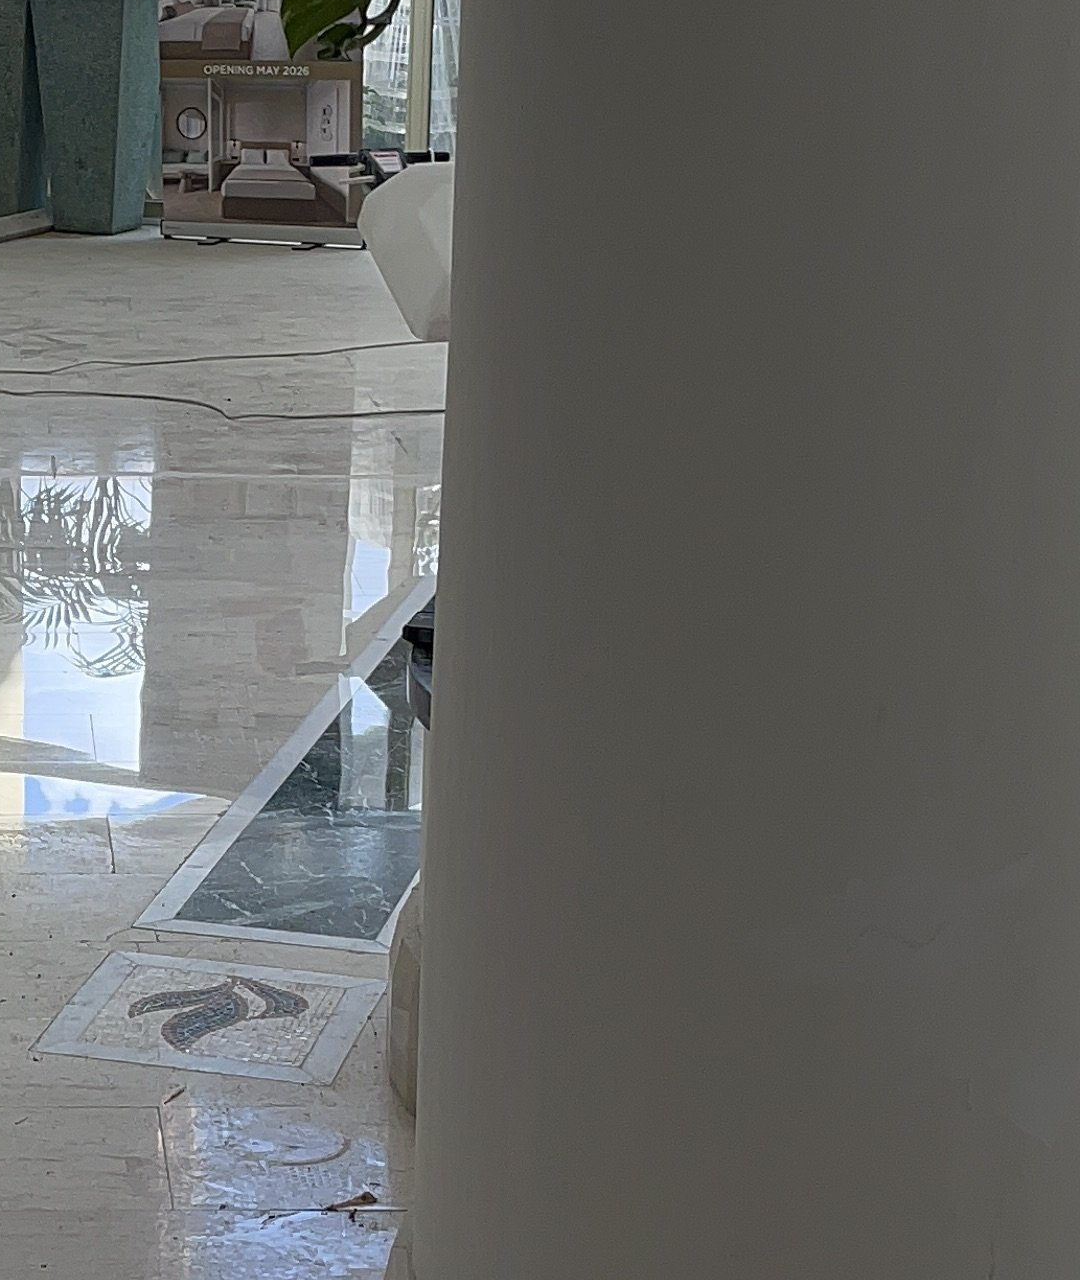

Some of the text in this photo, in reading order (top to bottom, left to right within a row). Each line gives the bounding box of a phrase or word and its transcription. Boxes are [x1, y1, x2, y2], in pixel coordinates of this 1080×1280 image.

[203, 64, 310, 76] OPENING MAY 2026
